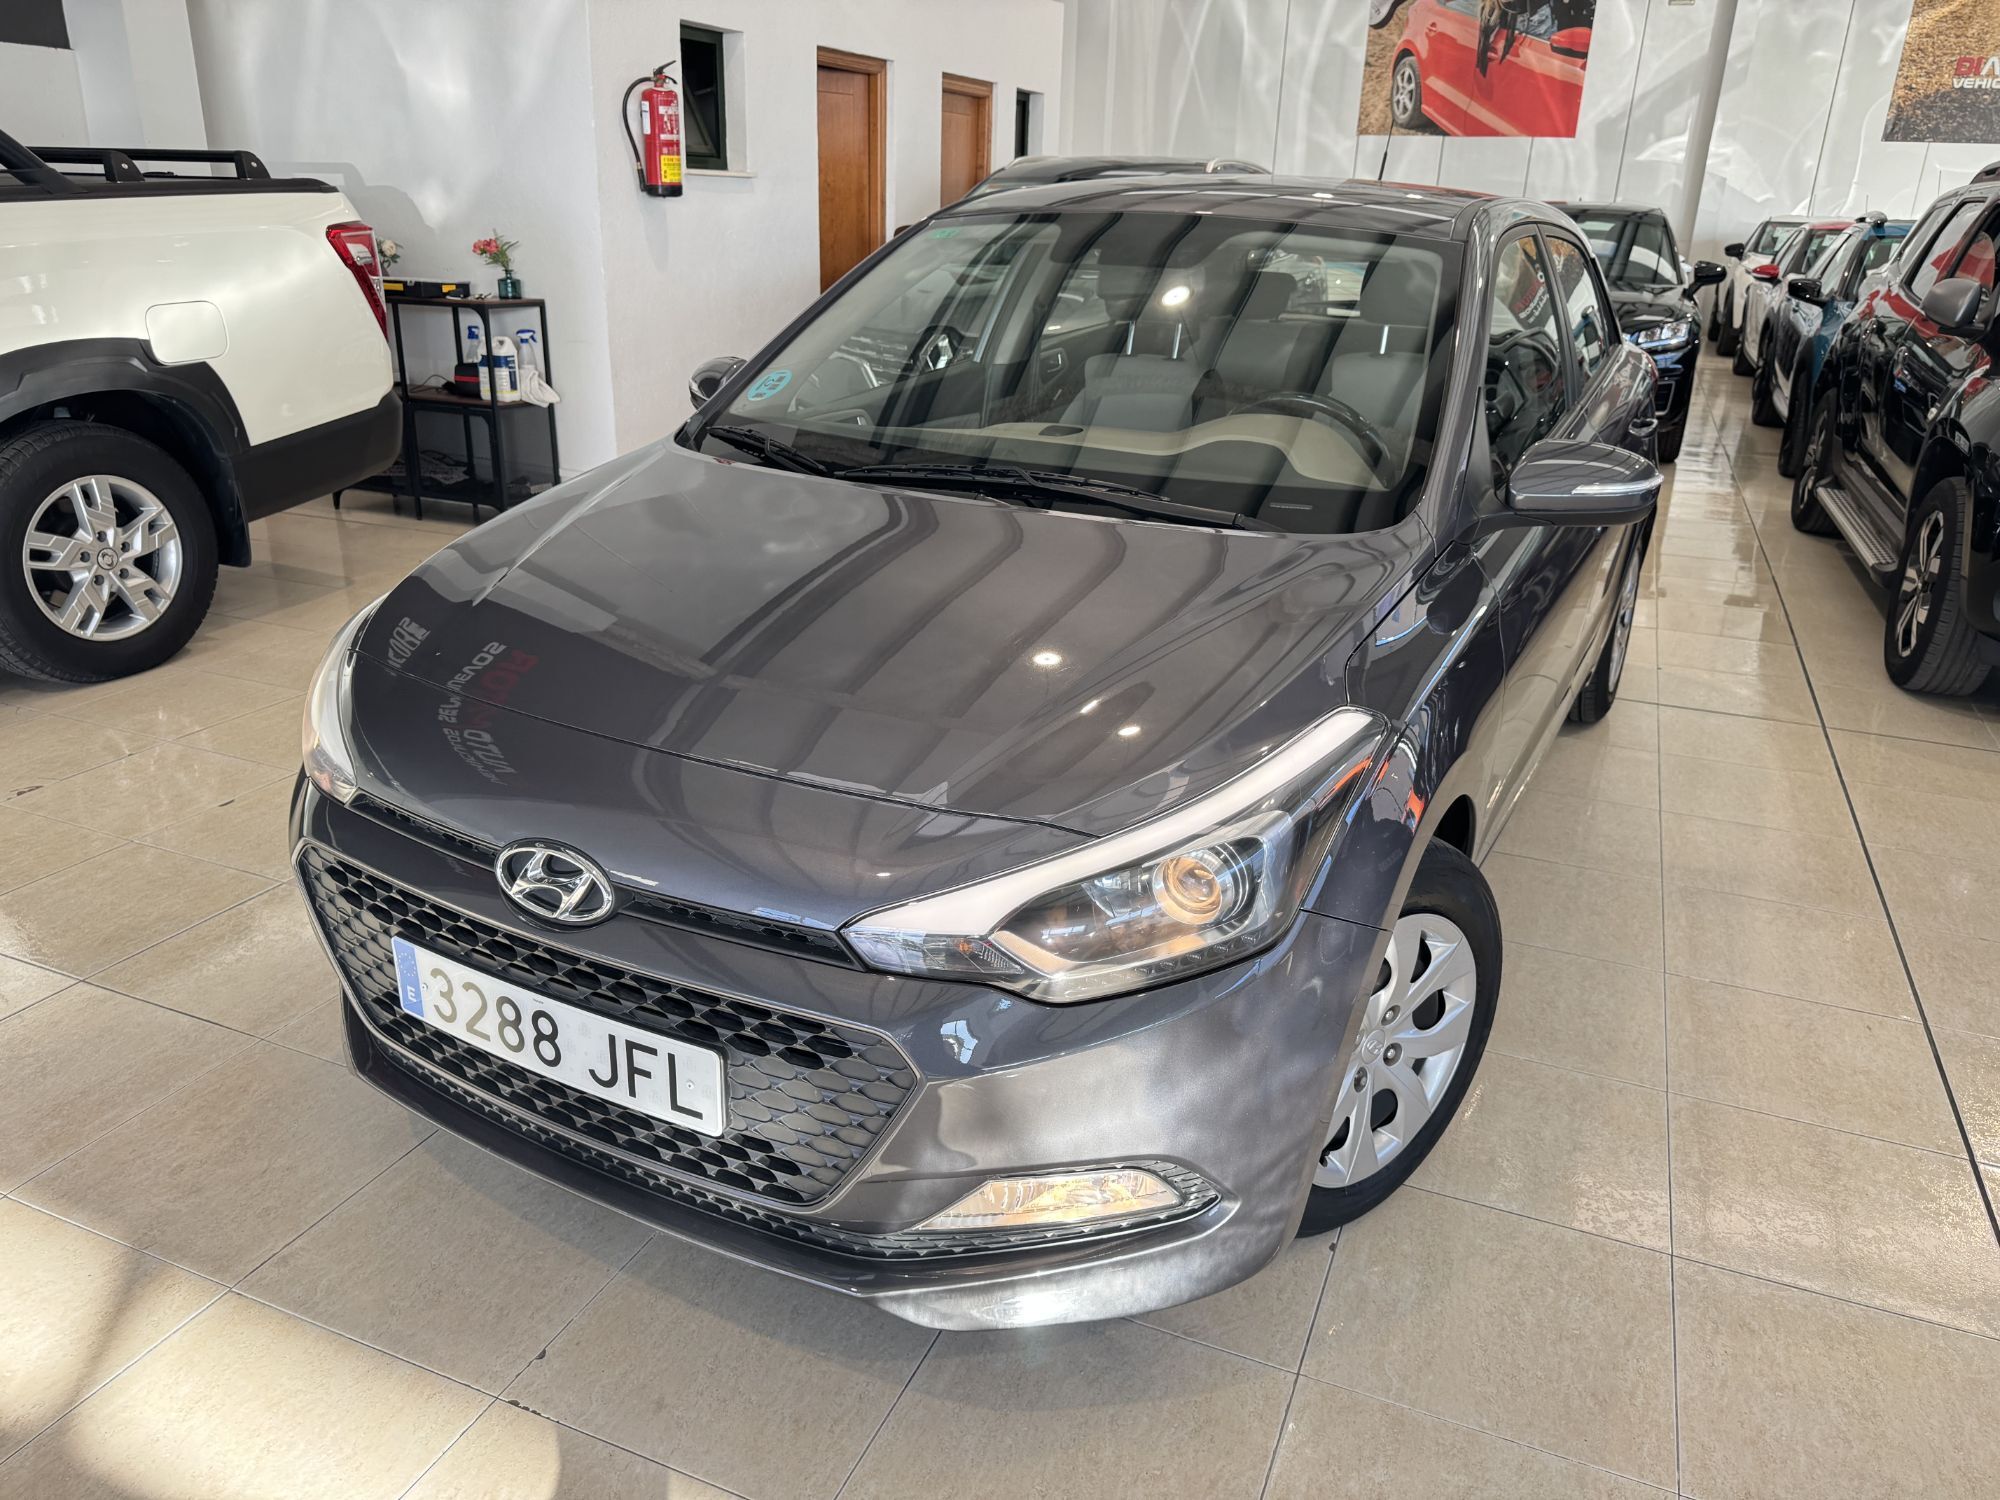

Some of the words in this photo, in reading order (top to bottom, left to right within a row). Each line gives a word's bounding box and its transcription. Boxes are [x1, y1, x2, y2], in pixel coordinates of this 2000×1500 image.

[406, 985, 417, 1002] E
[429, 966, 562, 1068] 3288
[587, 1032, 704, 1121] JFL
